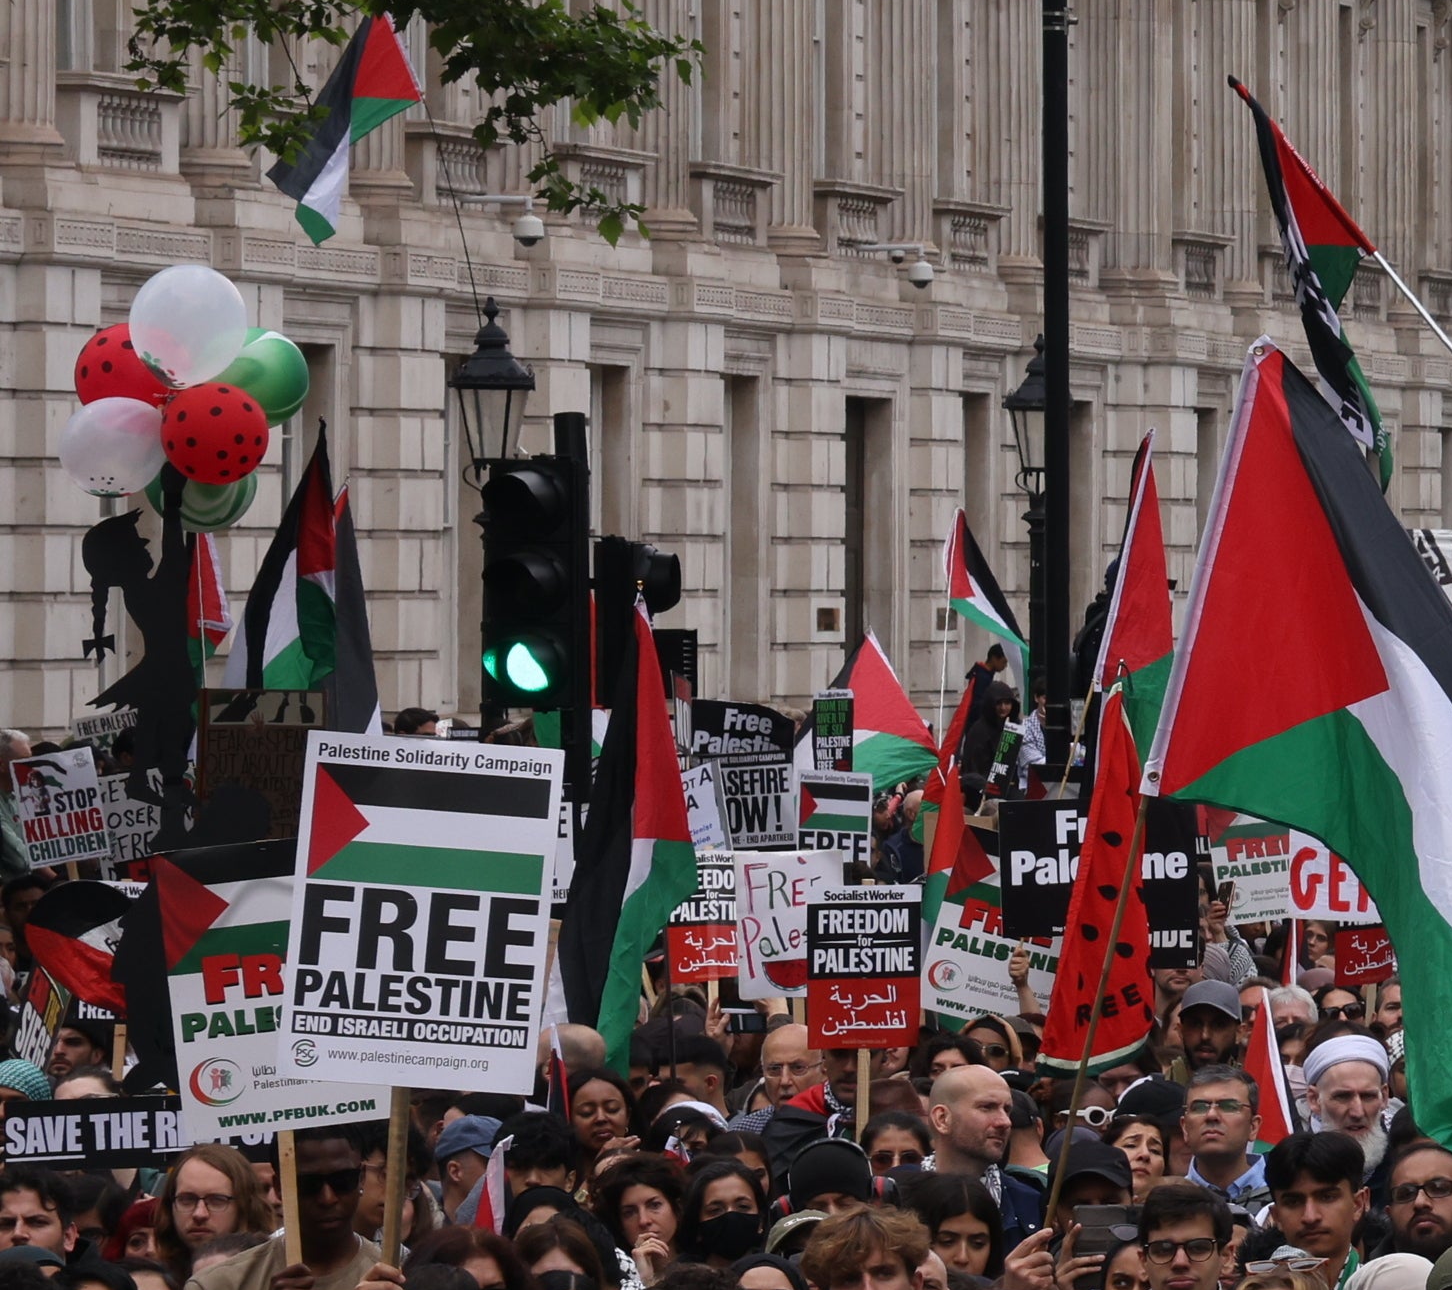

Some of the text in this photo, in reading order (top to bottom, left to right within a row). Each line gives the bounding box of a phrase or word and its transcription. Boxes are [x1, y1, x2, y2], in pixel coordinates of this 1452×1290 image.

[77, 720, 97, 736] FREE
[724, 708, 773, 733] Free
[816, 736, 851, 747] PALESTINE
[318, 742, 552, 775] Palestine Solidarity Campaign
[54, 787, 97, 813] STOP
[24, 807, 104, 843] KILLING
[760, 833, 794, 843] APARTHEID
[29, 832, 108, 863] CHILDREN
[799, 830, 868, 862] FREE
[823, 888, 905, 902] Socialist Worker
[298, 883, 540, 980] FREE
[817, 909, 909, 935] FREEDOM
[857, 934, 873, 947] for
[813, 947, 914, 974] PALESTINE
[294, 968, 532, 1021] PALESTINE
[830, 984, 897, 1010] الحرية
[294, 1014, 525, 1047] END ISRAELI OCCUPATION
[821, 1009, 907, 1037] لفلسطين
[328, 1048, 489, 1072] www.palestinecampaign.org
[218, 1099, 376, 1128] WWW.PFBUK.COM
[5, 1115, 85, 1155] SAVE
[88, 1112, 150, 1153] THE
